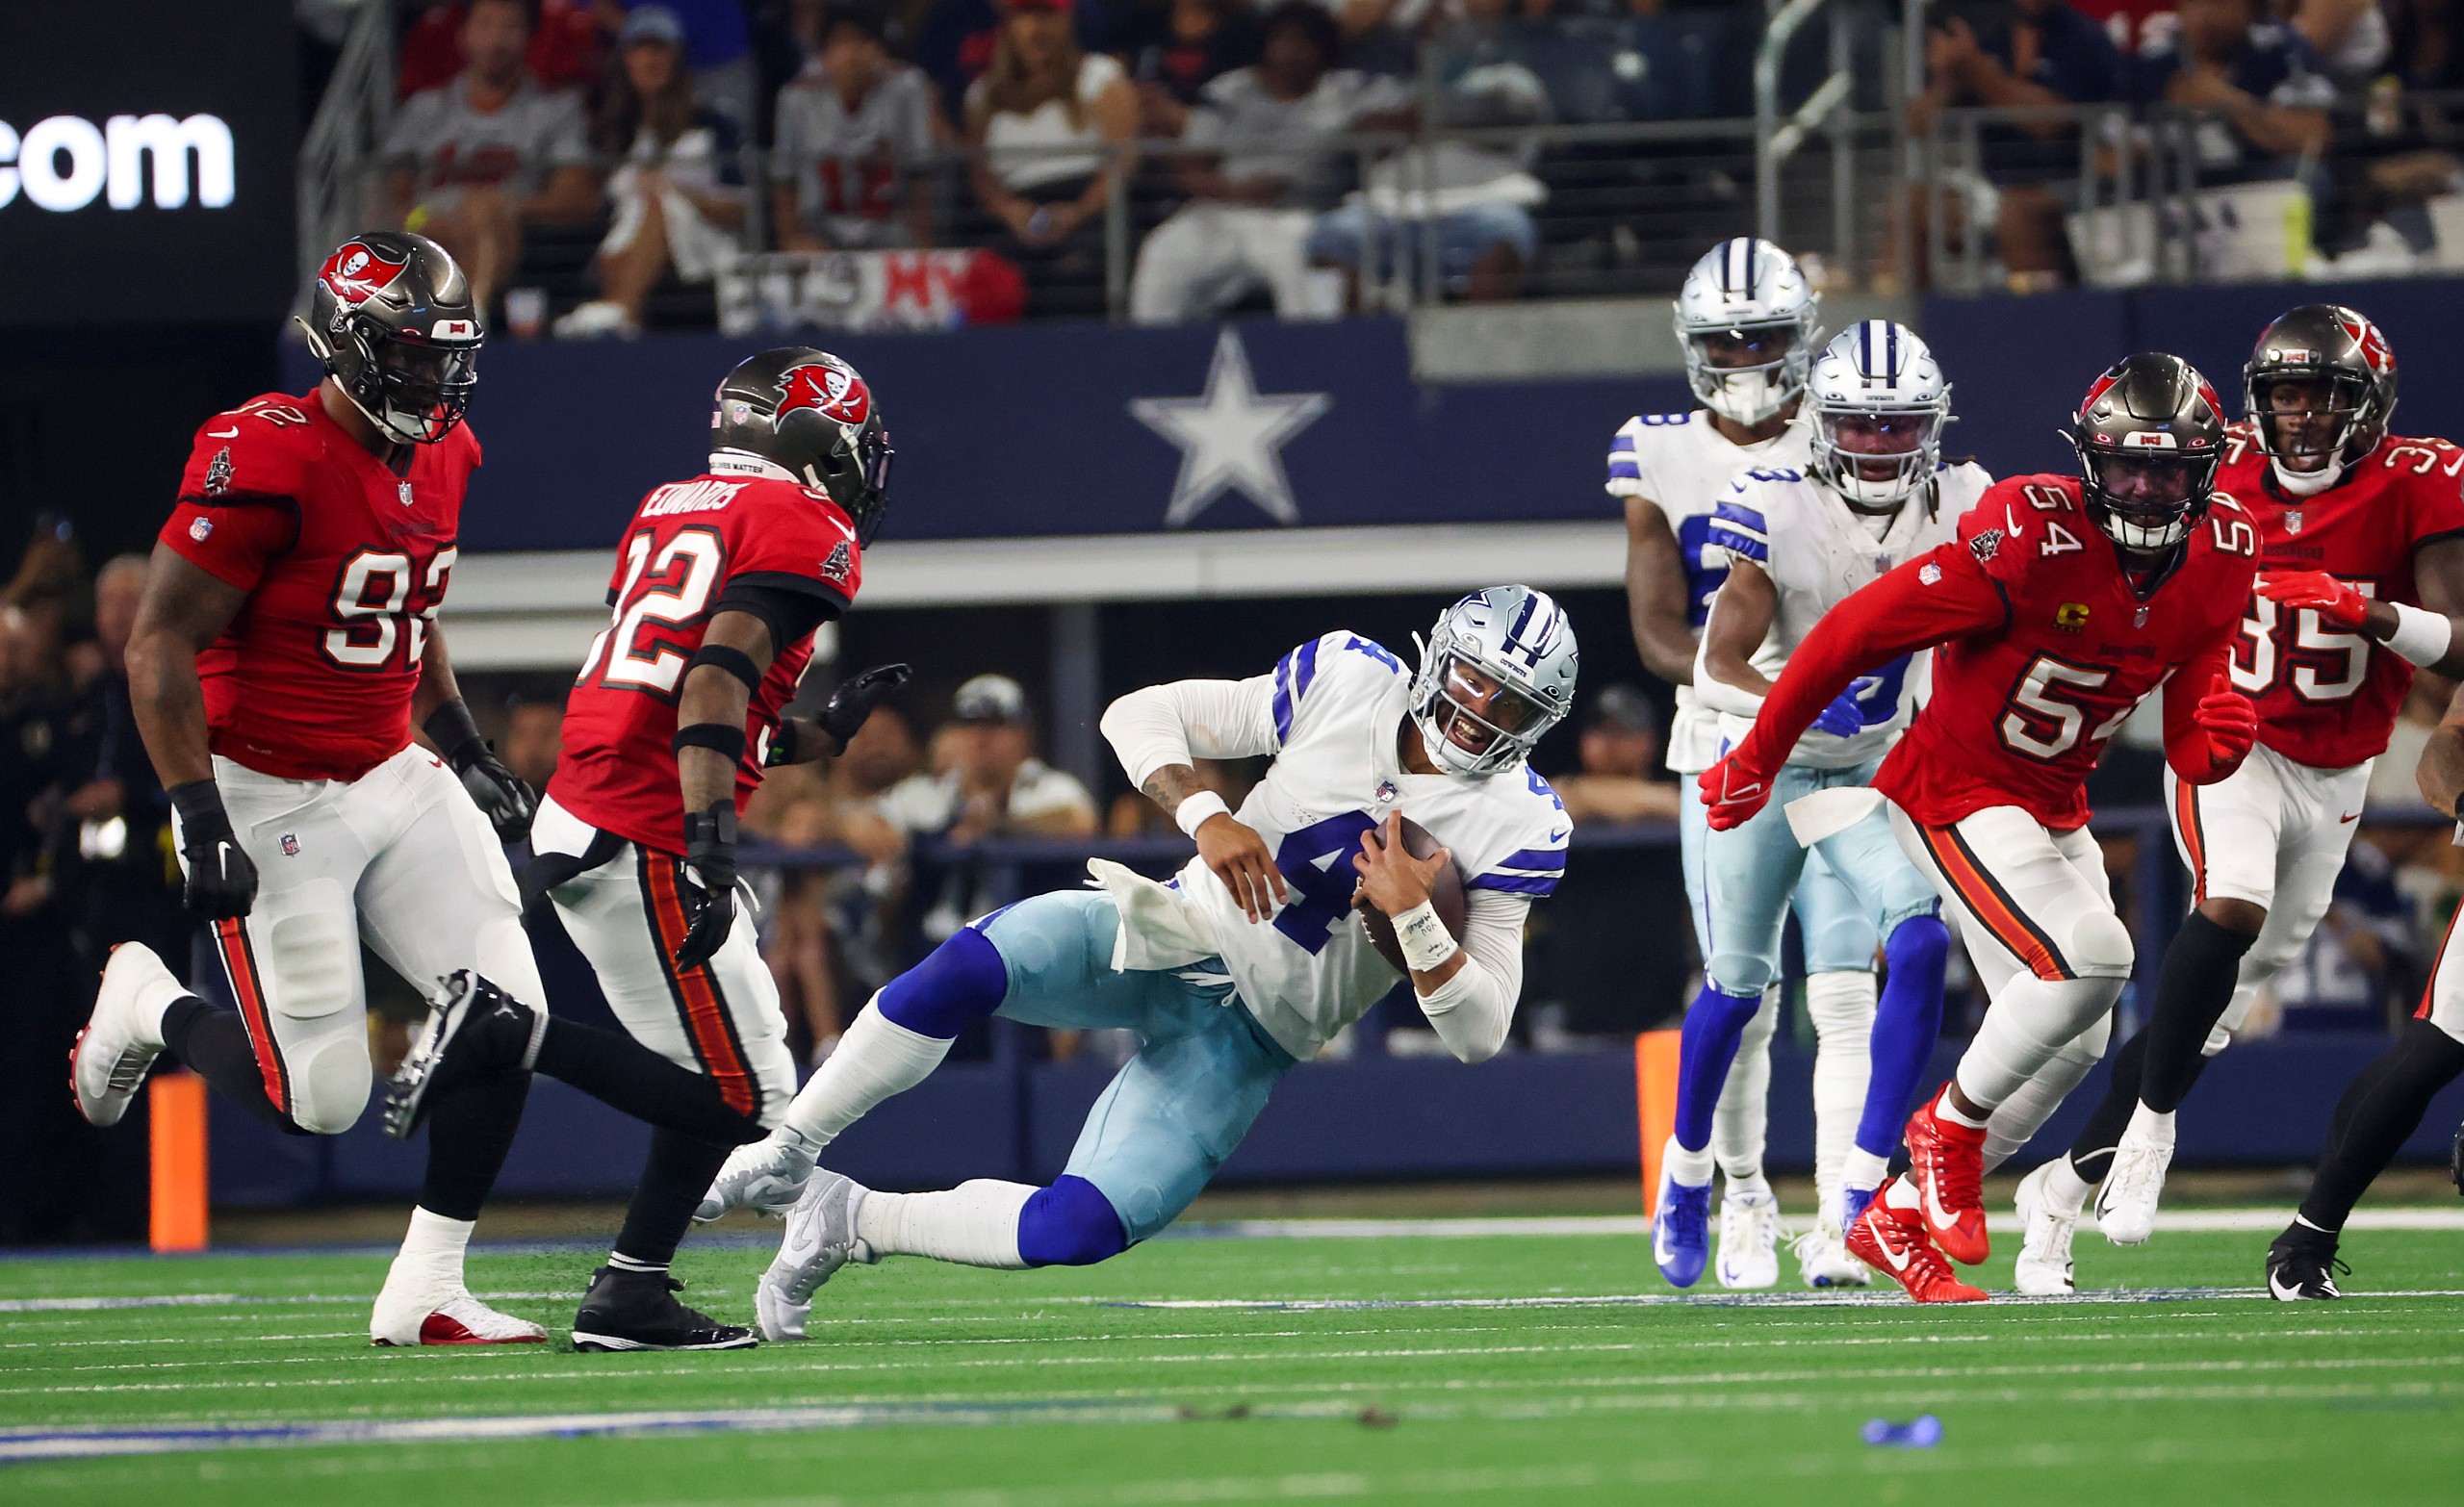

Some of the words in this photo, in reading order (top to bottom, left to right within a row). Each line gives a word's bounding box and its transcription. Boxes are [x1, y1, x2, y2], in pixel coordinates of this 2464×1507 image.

[0, 114, 235, 212] om
[640, 480, 751, 518] EDWARDS
[733, 463, 763, 473] MATTER
[2023, 484, 2084, 557] 54
[321, 542, 459, 672] 92
[2056, 601, 2090, 626] C
[2220, 575, 2375, 707] 35
[1345, 636, 1399, 675] 4
[1272, 809, 1378, 957] 4
